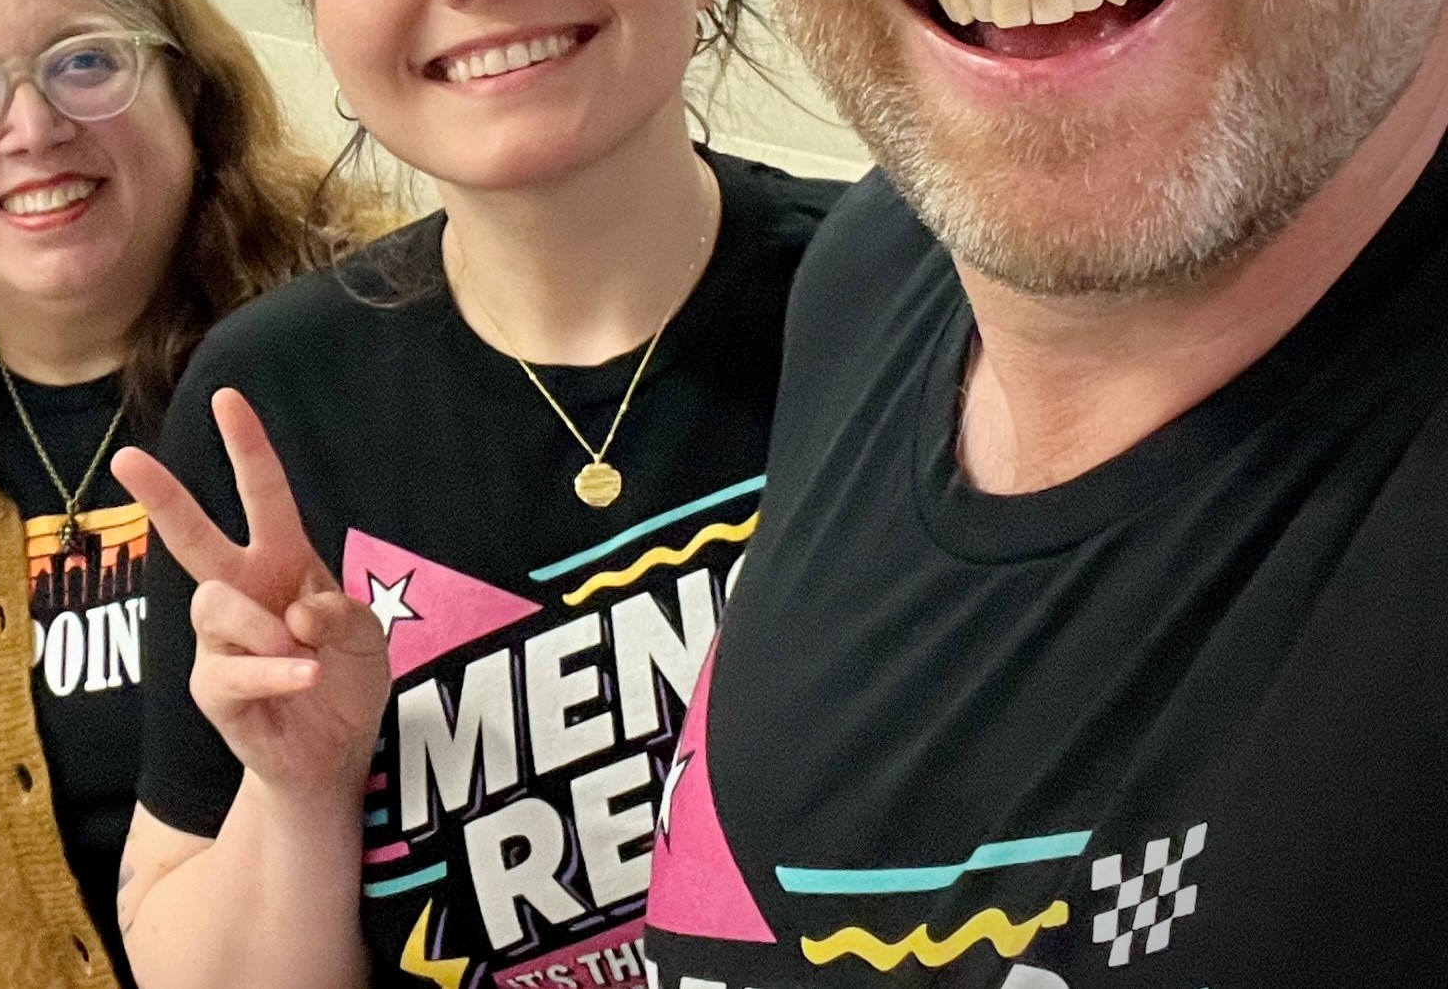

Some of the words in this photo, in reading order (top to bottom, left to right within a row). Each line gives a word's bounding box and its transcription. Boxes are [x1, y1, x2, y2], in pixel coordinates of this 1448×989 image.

[31, 597, 147, 696] OIN
[398, 554, 747, 832] MEN
[463, 751, 655, 951] RE
